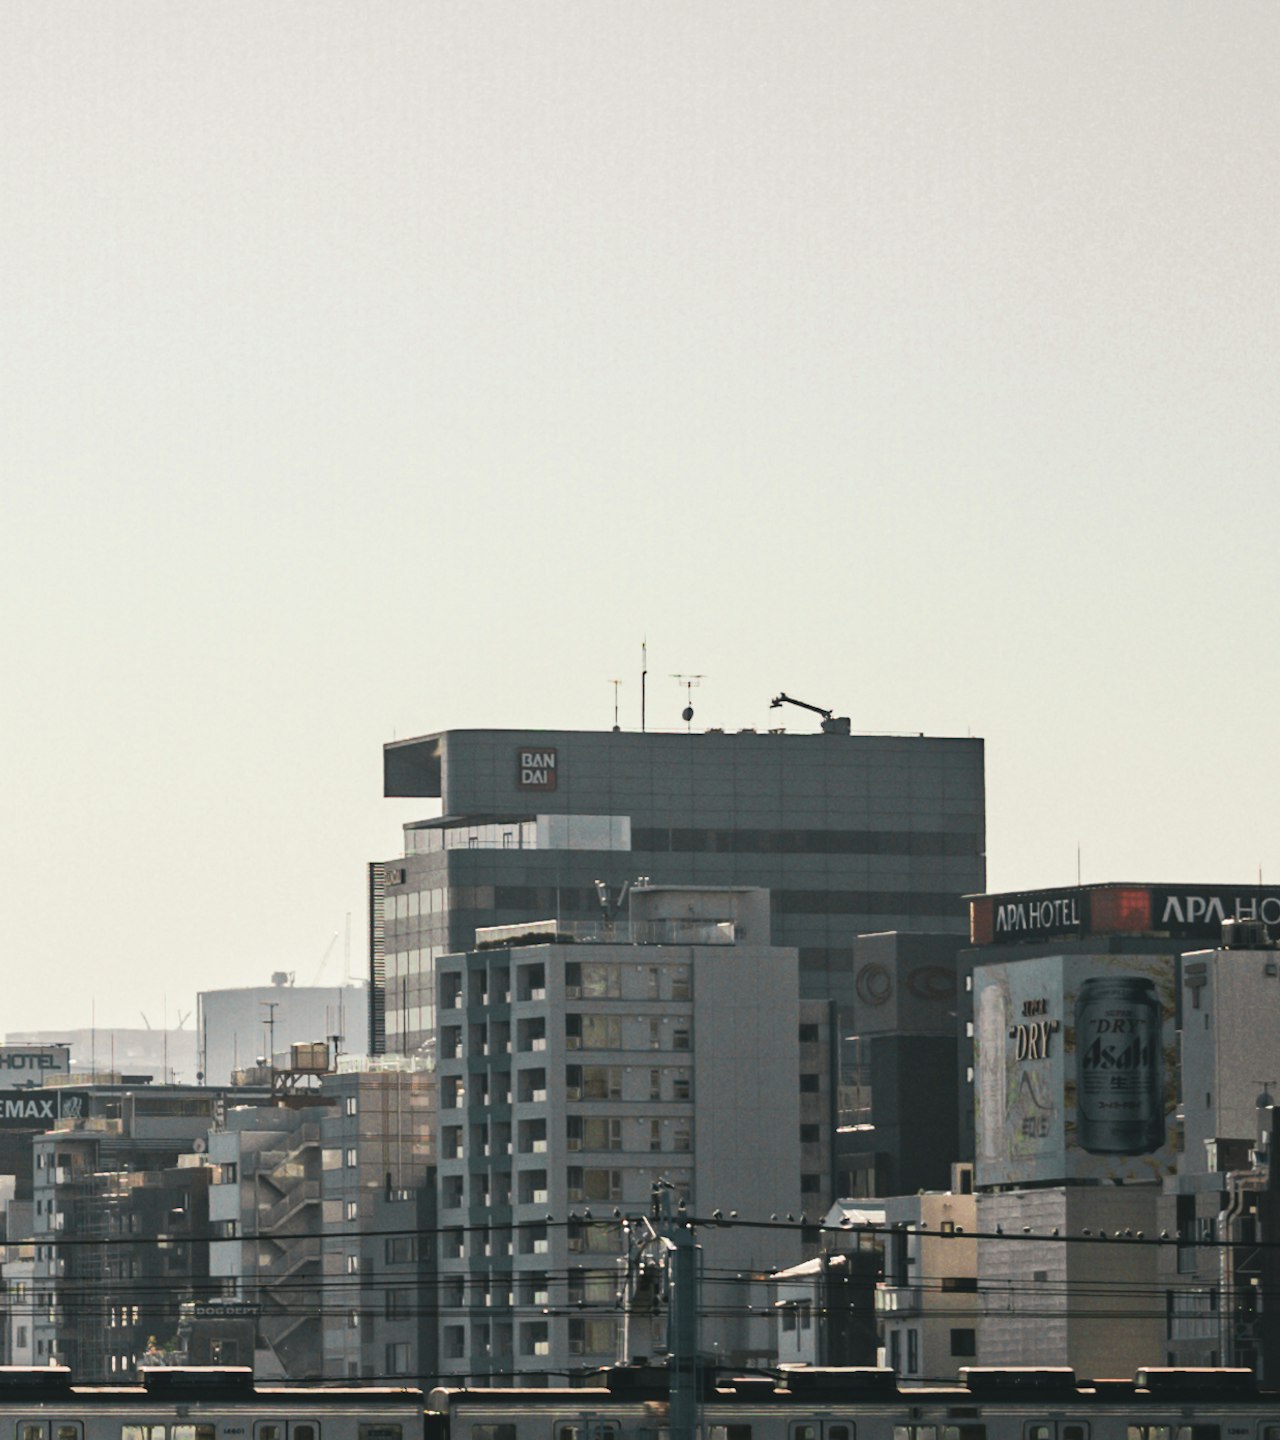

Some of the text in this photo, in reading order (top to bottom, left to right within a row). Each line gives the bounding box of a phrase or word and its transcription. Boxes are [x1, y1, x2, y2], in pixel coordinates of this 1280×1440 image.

[521, 752, 556, 769] BAN
[521, 769, 548, 785] DAI
[996, 898, 1081, 932] APA HOTEL
[1161, 895, 1226, 924] APA
[1082, 1035, 1157, 1070] Asahi
[1110, 1075, 1129, 1090] 生
[196, 1306, 259, 1315] DOG DEPT
